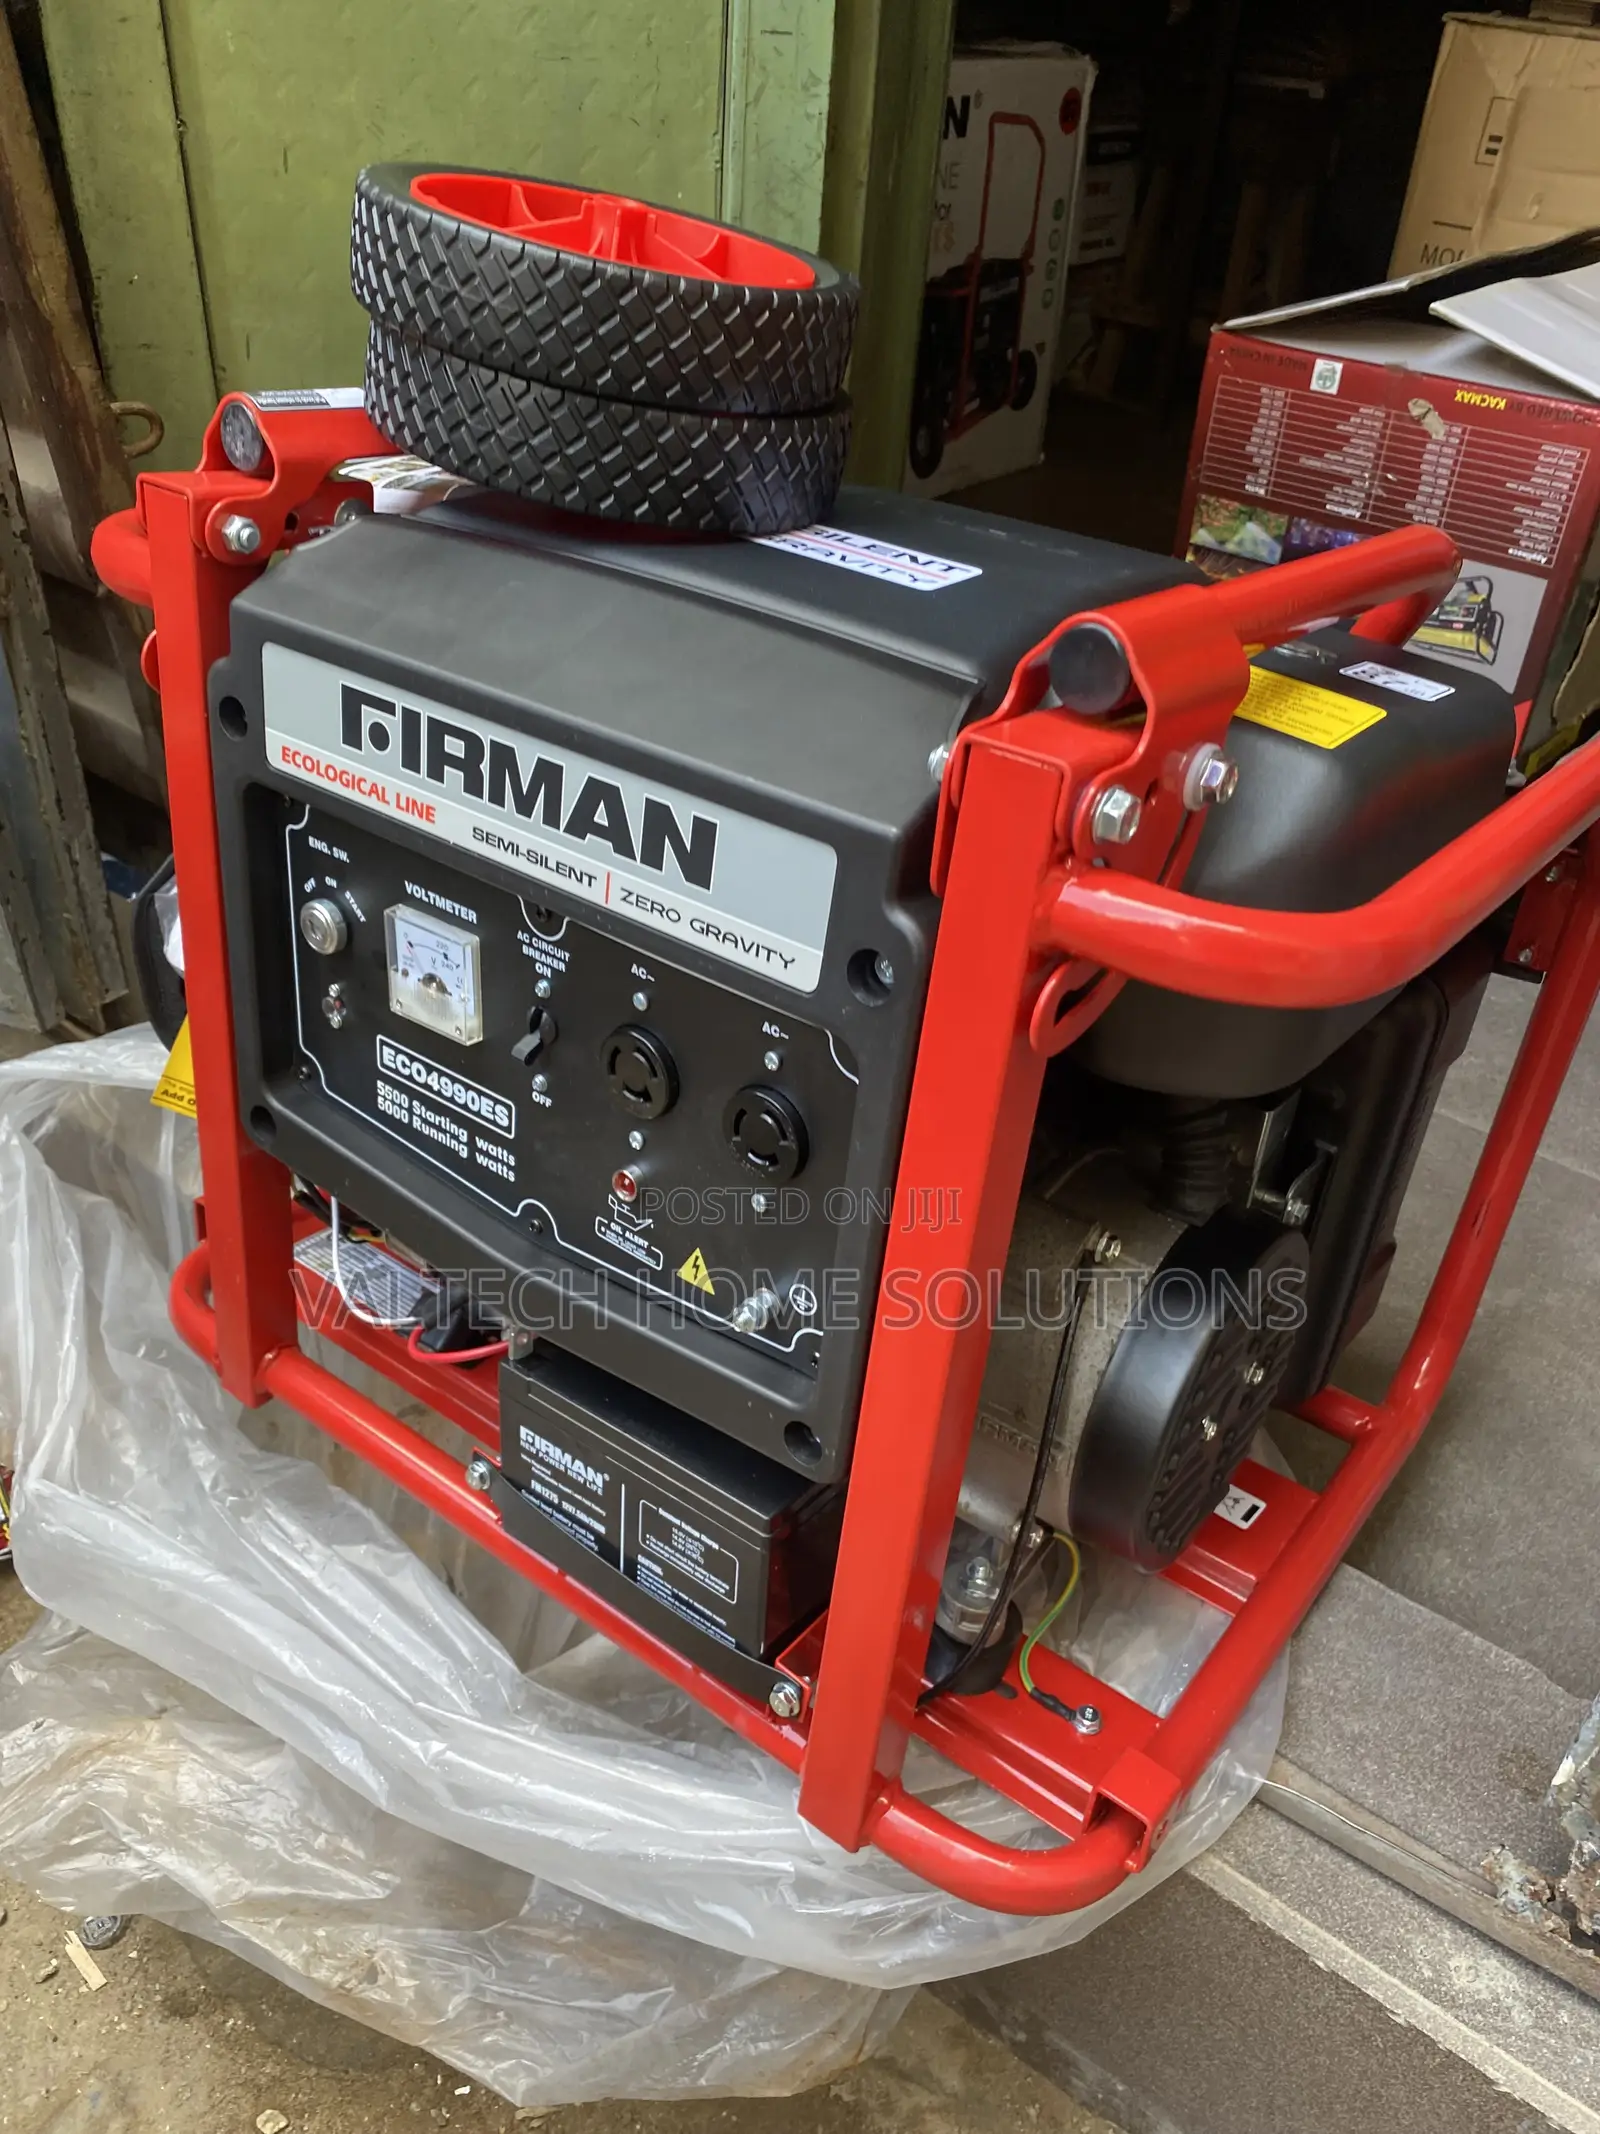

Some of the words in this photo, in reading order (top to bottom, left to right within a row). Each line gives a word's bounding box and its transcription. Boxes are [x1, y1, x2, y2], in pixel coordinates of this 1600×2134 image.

[1453, 390, 1507, 411] KACMAX
[281, 745, 390, 805] ECOLOGICAL
[395, 791, 437, 824] LINE
[340, 681, 719, 894] FIRMAN
[308, 836, 331, 856] ENG.
[333, 847, 350, 863] SW.
[304, 877, 317, 893] OFF
[325, 875, 338, 888] ON
[471, 826, 598, 889] SEMI-SILENT
[620, 887, 682, 924] ZERO
[689, 918, 796, 970] GRAVITY
[344, 890, 367, 923] START
[404, 880, 478, 925] VOLTMETER
[517, 930, 530, 943] AC
[531, 937, 571, 962] CIRCUIT
[522, 944, 566, 973] BREAKER
[535, 962, 551, 979] ON
[382, 1044, 509, 1128] ECO4990ES
[532, 1091, 553, 1109] OFF
[376, 1079, 409, 1109] 5500
[411, 1100, 468, 1143] Starting
[475, 1136, 516, 1167] watts
[377, 1096, 409, 1124] 5000
[412, 1115, 468, 1159] Running
[475, 1152, 516, 1183] watts
[610, 1222, 623, 1235] OIL
[624, 1230, 649, 1248] ALERT
[519, 1425, 604, 1489] FIRMAN
[520, 1440, 537, 1454] NEW
[539, 1450, 566, 1473] POWER
[567, 1468, 584, 1483] NEW
[586, 1481, 603, 1495] LIFE
